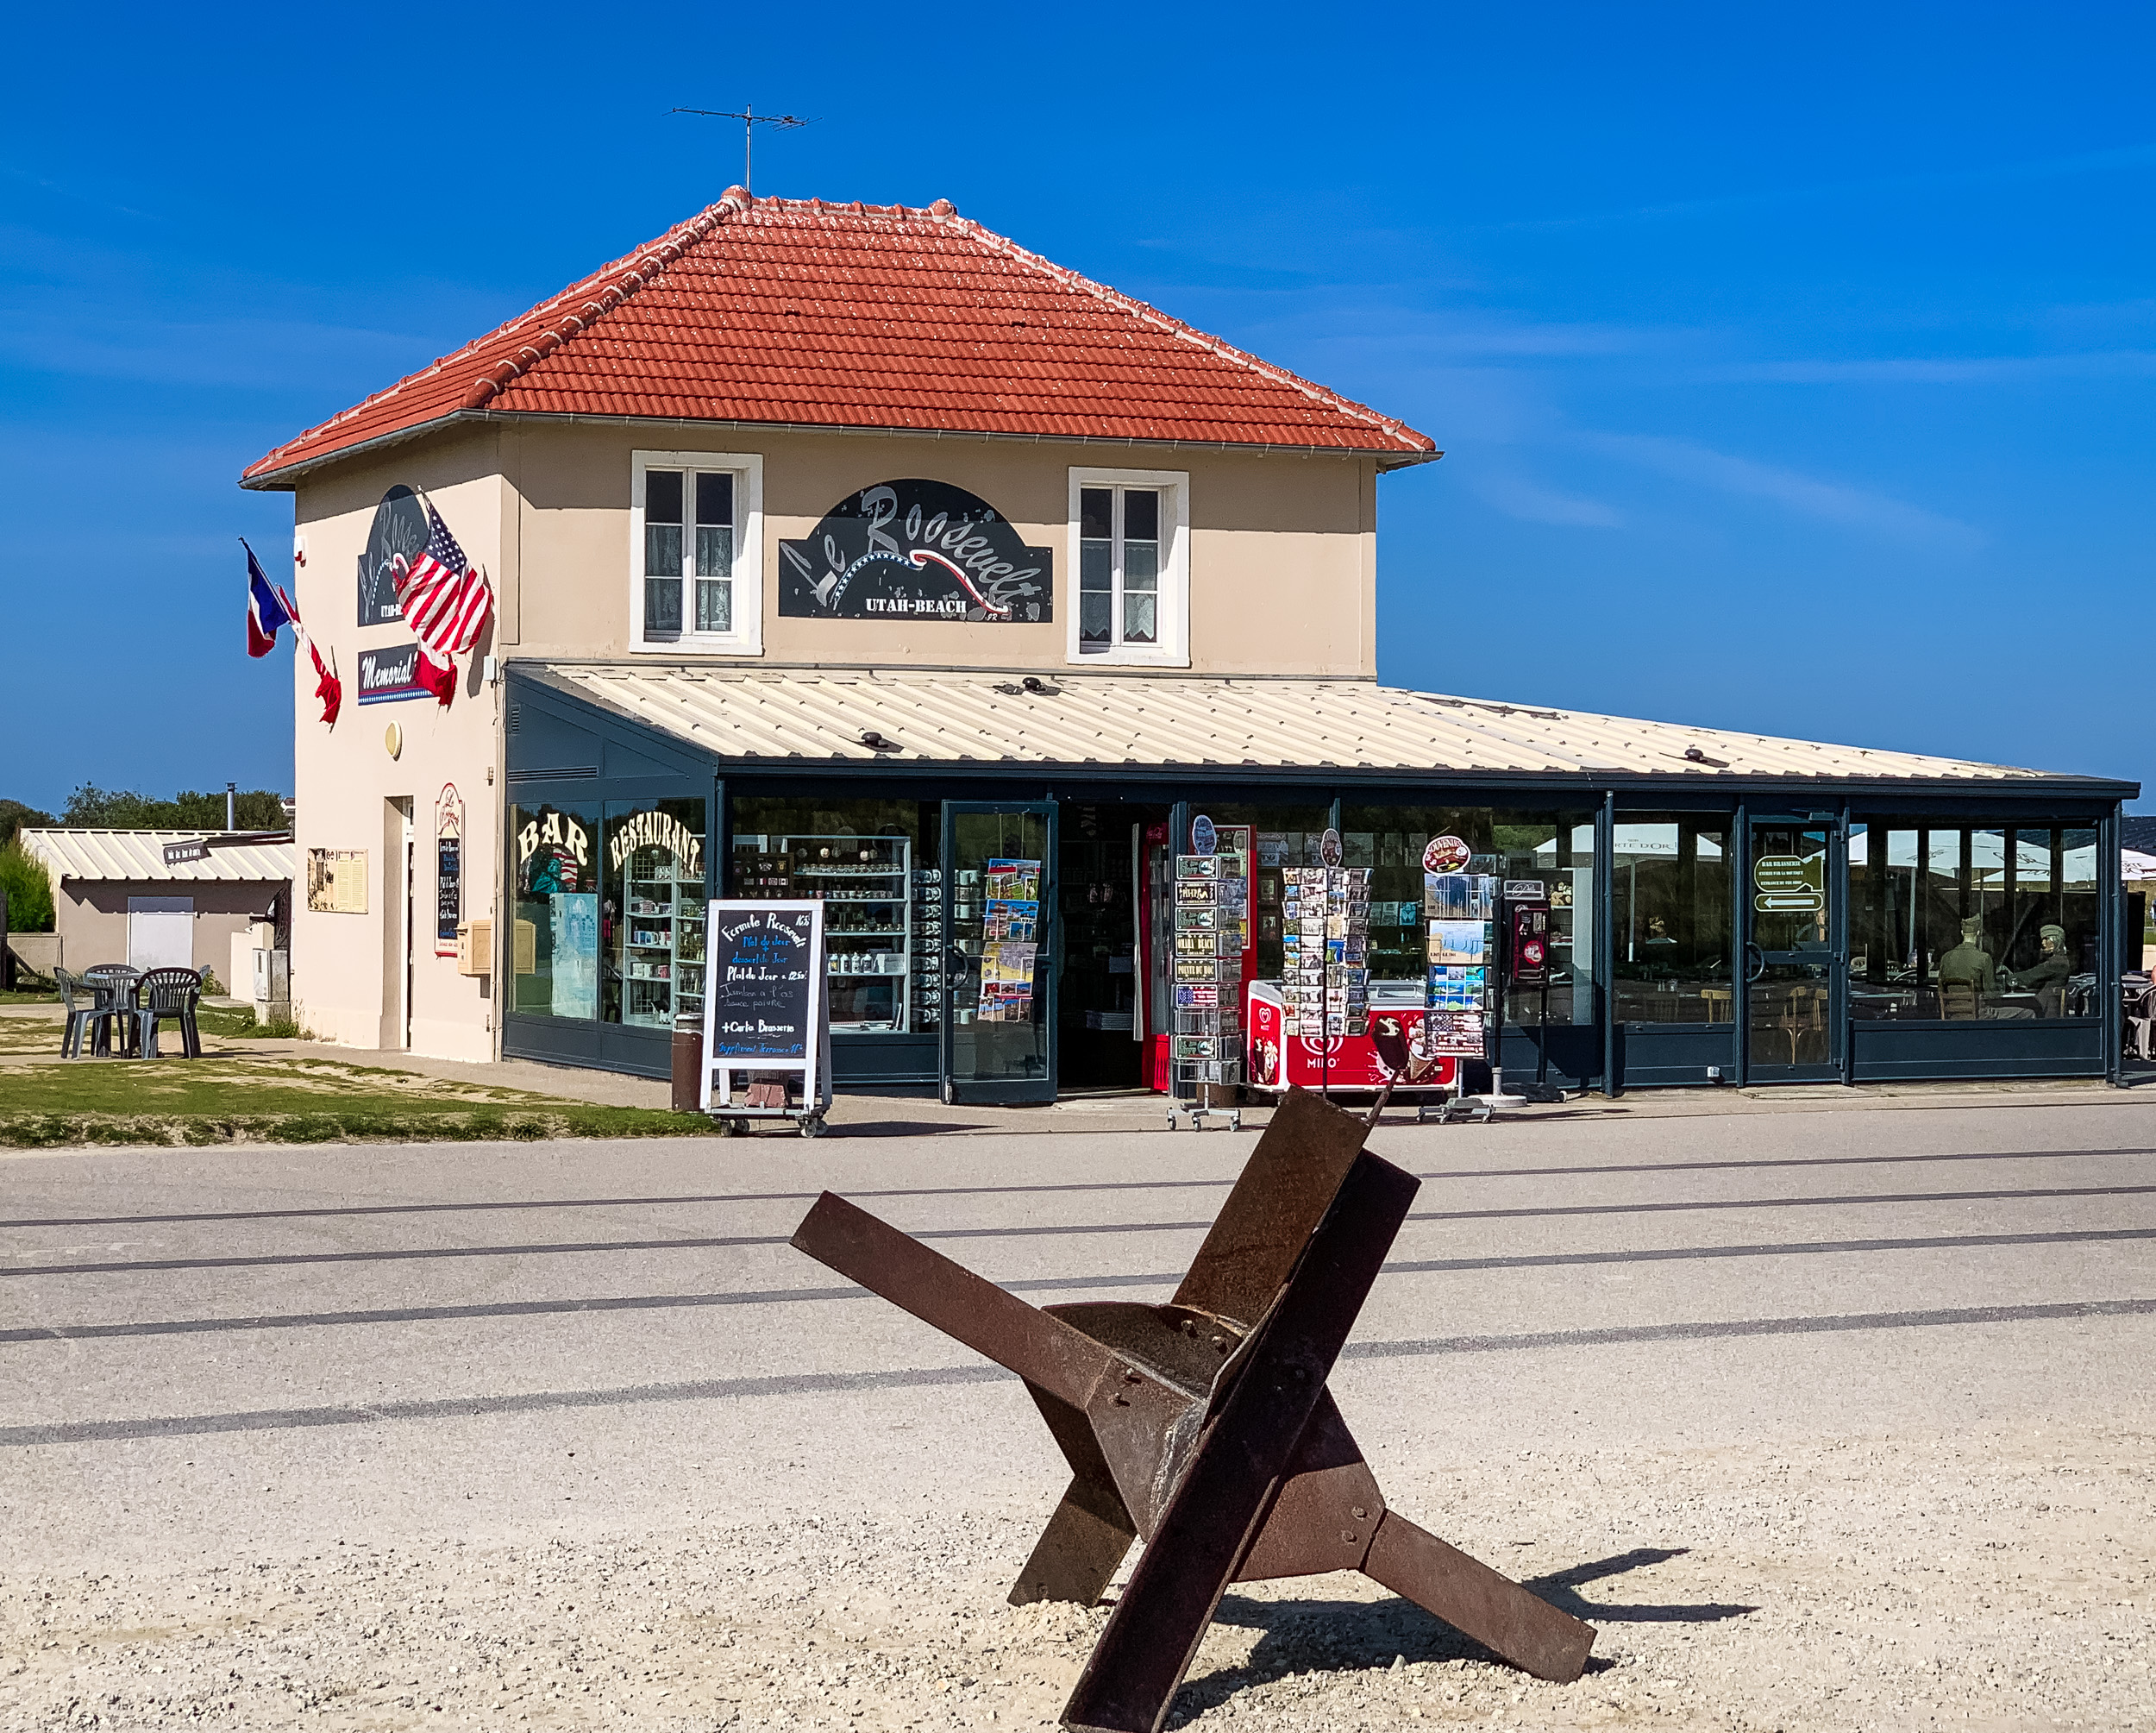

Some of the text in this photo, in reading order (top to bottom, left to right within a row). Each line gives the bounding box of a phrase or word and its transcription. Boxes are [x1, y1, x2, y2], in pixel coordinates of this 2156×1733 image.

[780, 485, 1043, 607] Le Roosevelt
[865, 597, 968, 615] UTAH-BEACH
[361, 652, 412, 690] Memorial
[518, 813, 588, 866] BAR
[611, 811, 700, 874] RESTAURANT
